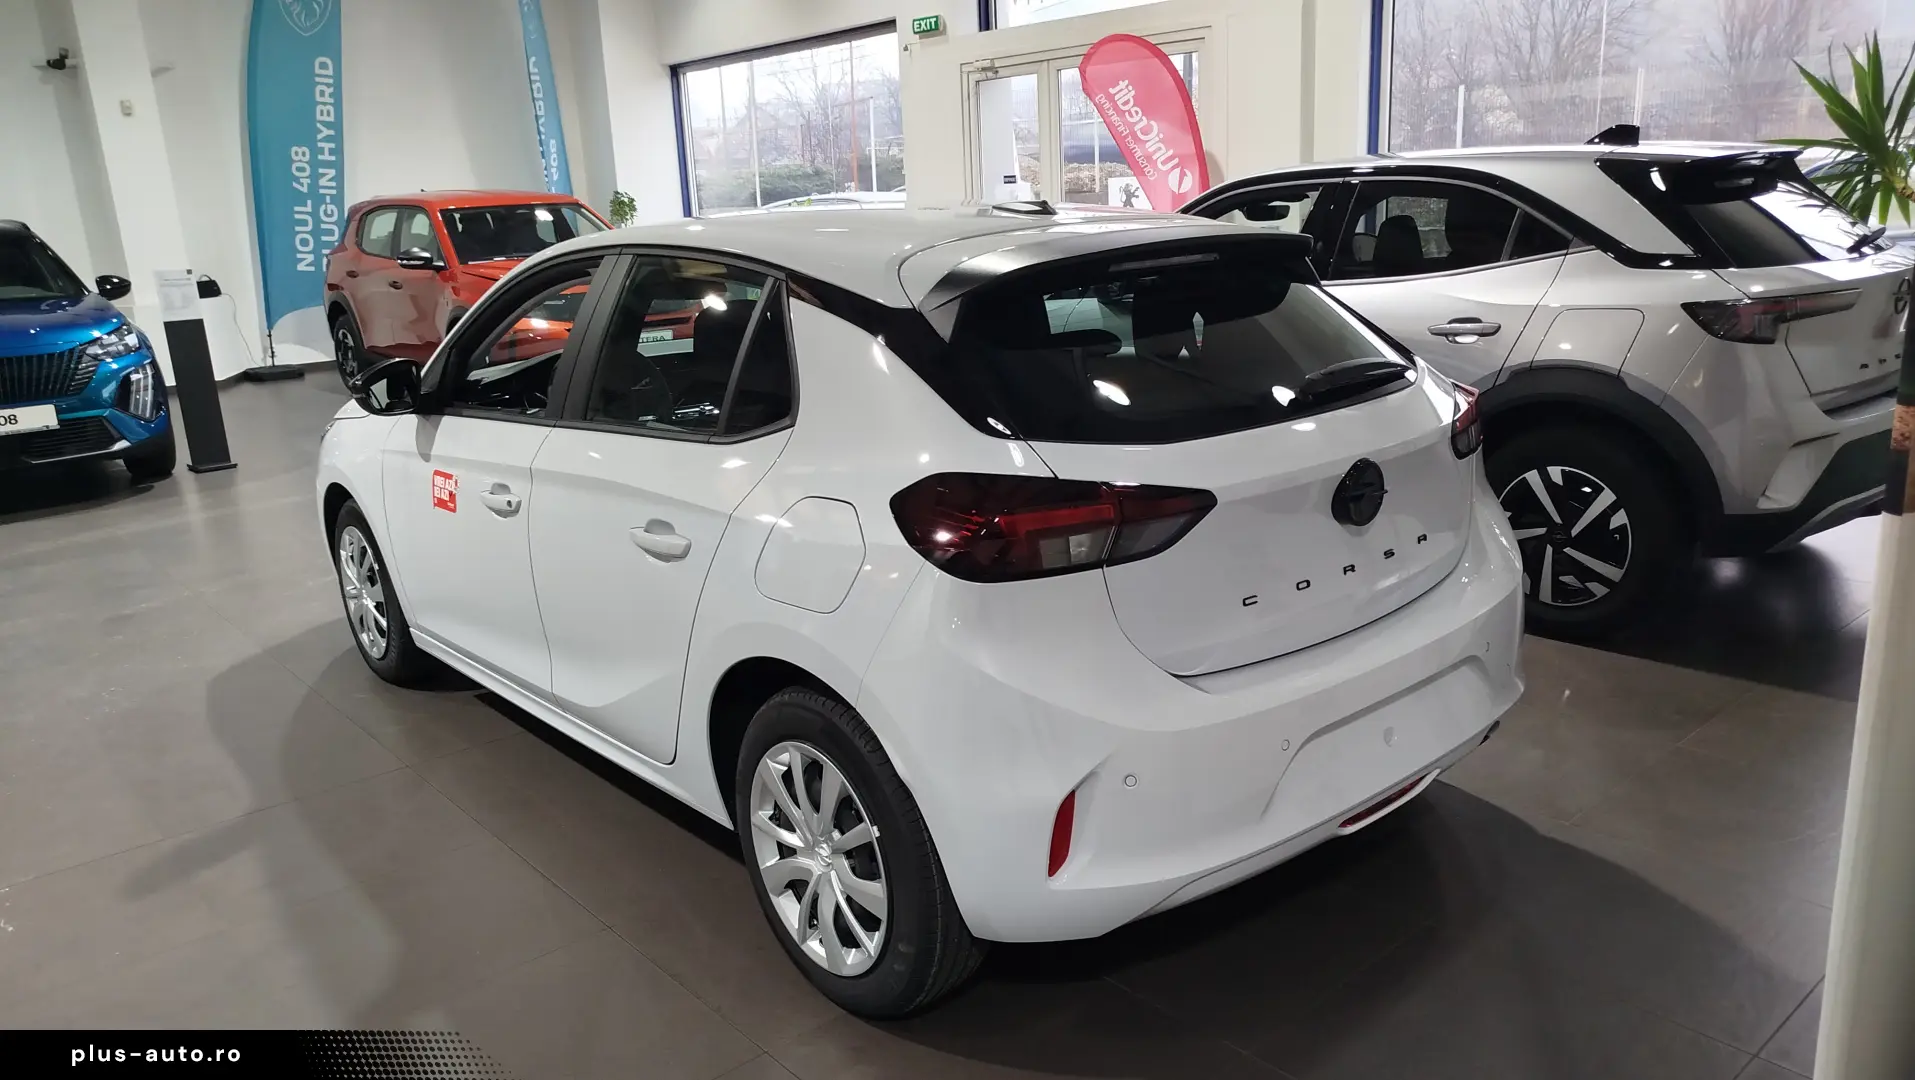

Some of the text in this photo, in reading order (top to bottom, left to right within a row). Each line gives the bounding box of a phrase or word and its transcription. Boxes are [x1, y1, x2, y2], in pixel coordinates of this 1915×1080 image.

[913, 17, 937, 32] EXIT
[314, 56, 336, 161] HYBRID
[290, 145, 316, 272] NOUL 408
[1242, 533, 1428, 607] CORSA
